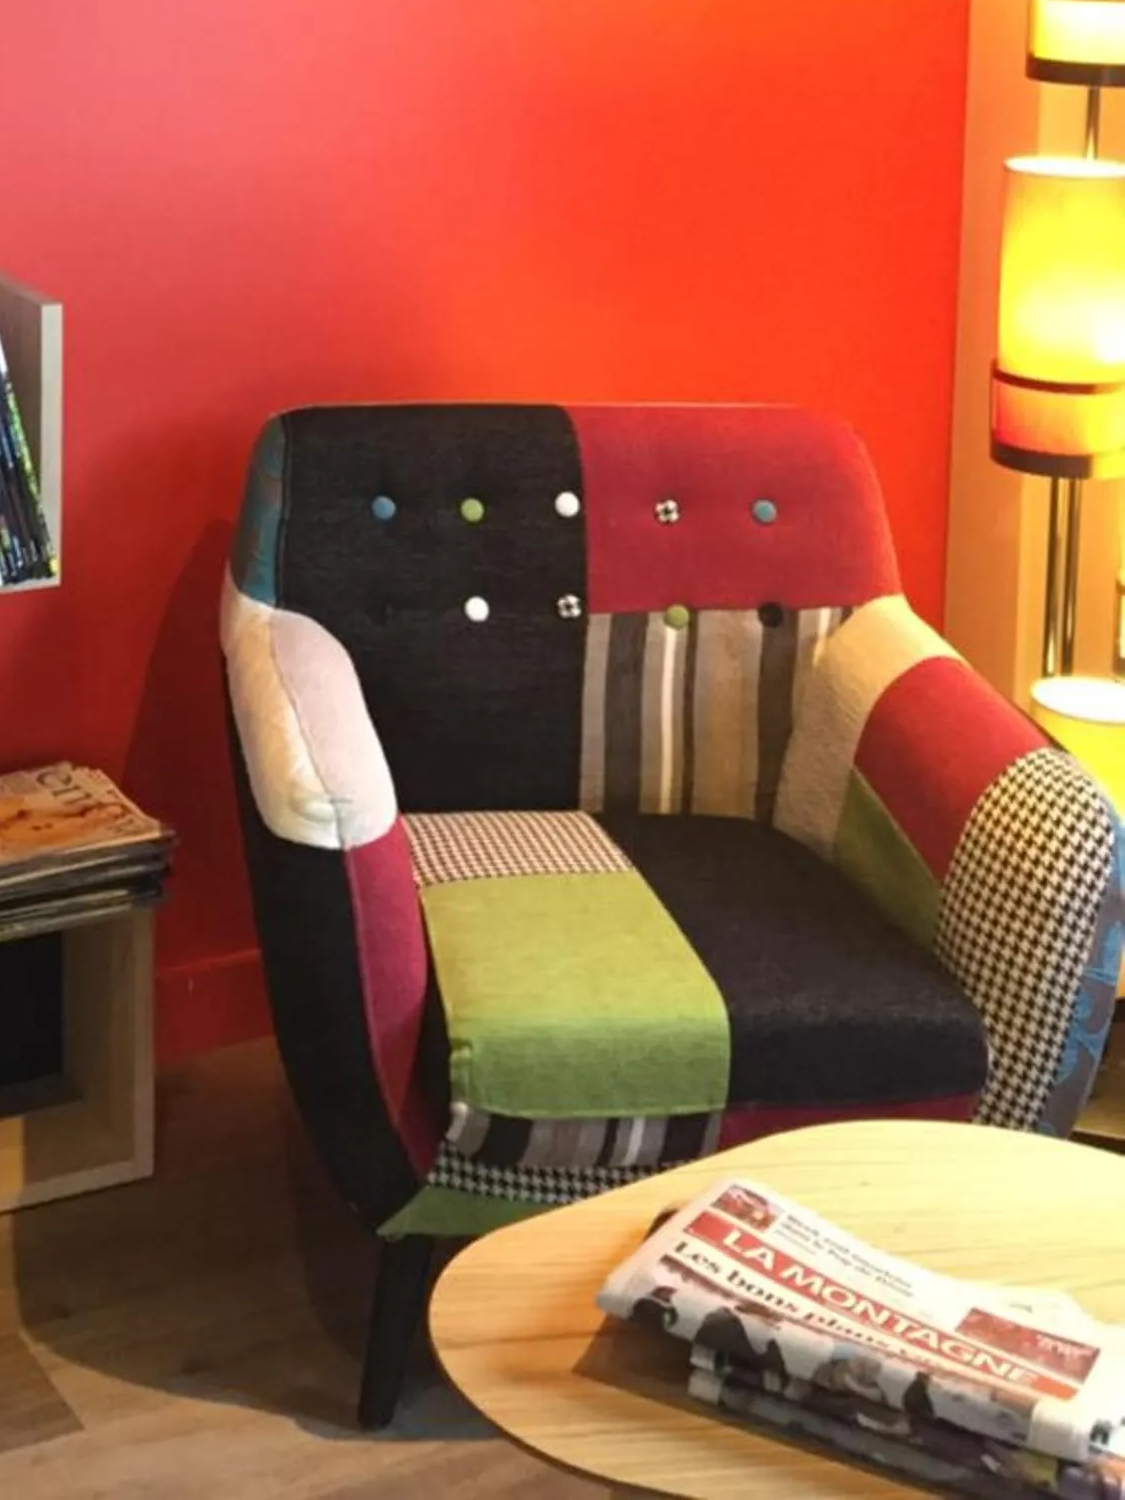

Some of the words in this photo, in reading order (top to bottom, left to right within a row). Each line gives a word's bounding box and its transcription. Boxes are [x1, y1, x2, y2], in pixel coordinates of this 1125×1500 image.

[674, 1241, 724, 1276] Les
[727, 1268, 799, 1318] bons
[721, 1227, 776, 1271] LA
[781, 1264, 1038, 1388] MONTAGNE
